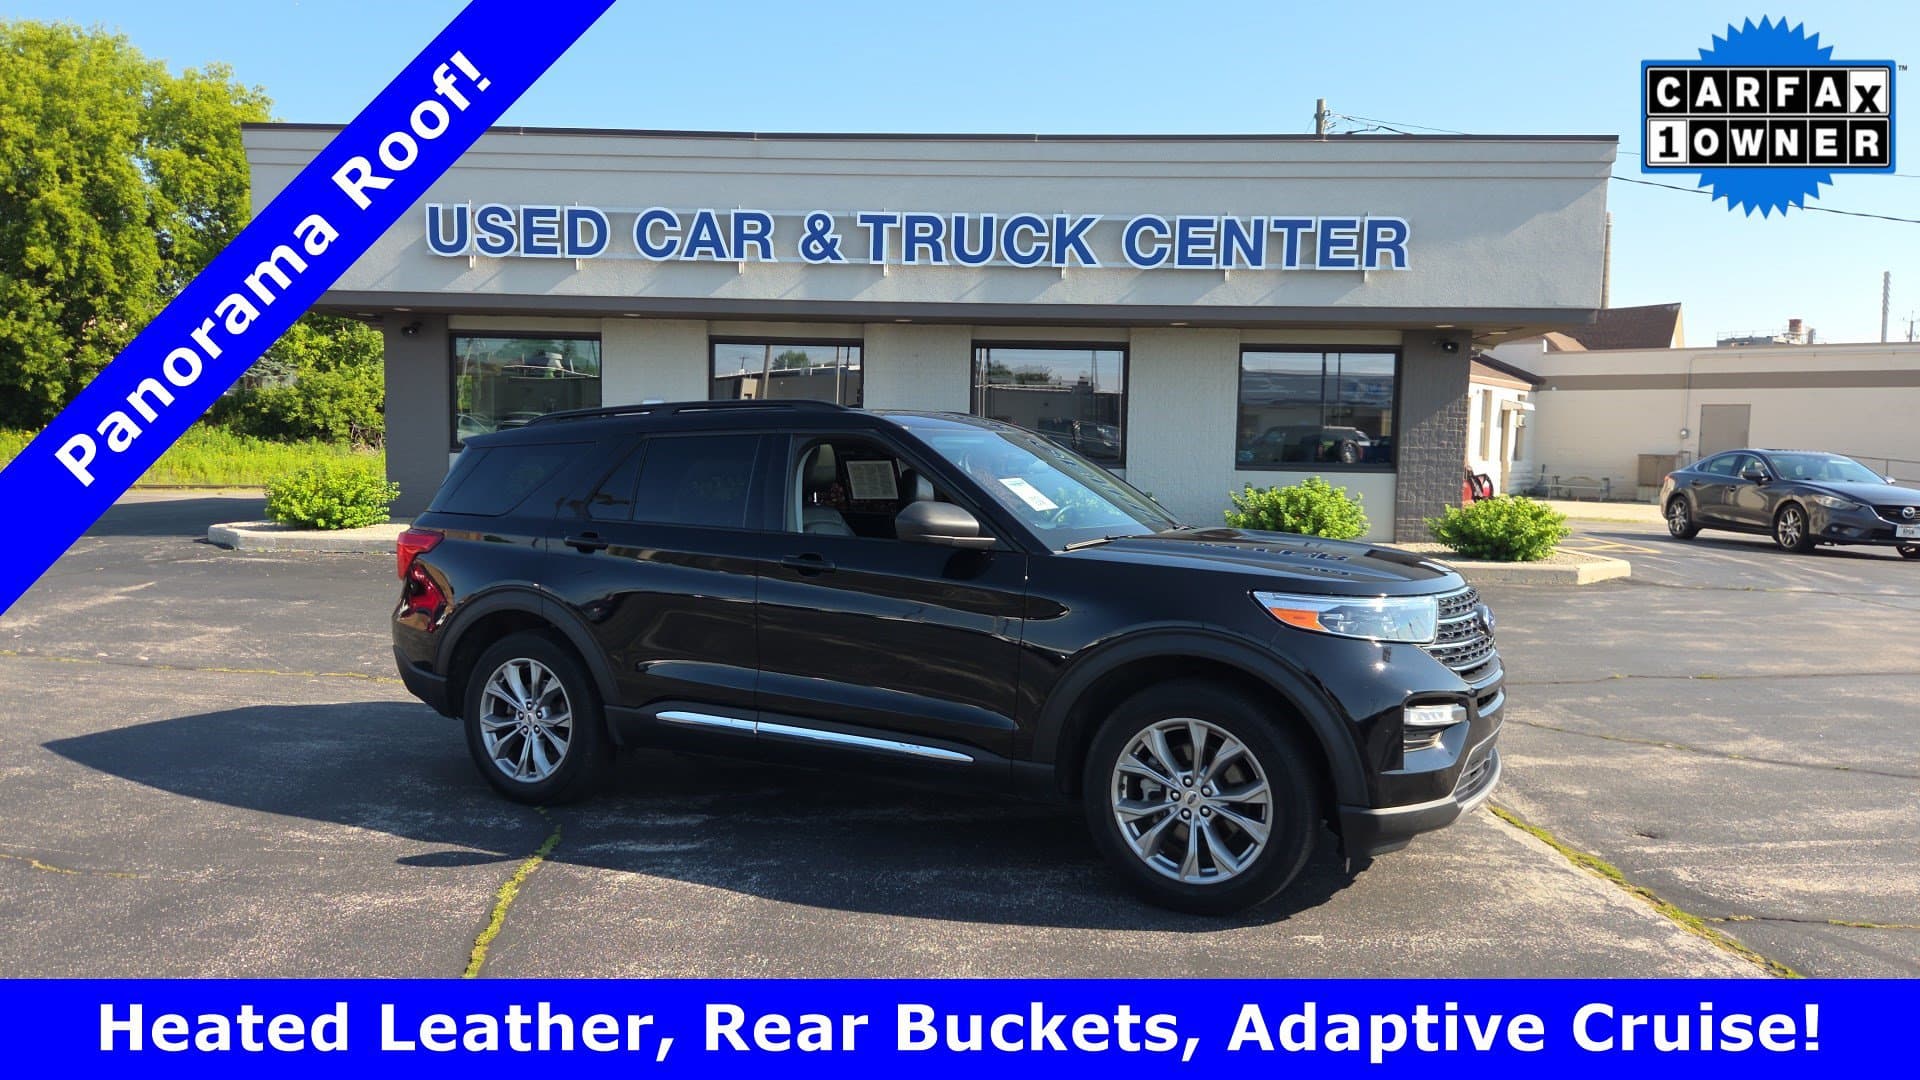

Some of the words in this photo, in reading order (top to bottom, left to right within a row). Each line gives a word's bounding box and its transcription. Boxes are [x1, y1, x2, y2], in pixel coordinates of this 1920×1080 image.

[425, 203, 610, 258] USED
[633, 207, 777, 262] CAR
[798, 210, 848, 264] &
[857, 211, 1099, 268] TRUCK
[1121, 215, 1411, 271] CENTER
